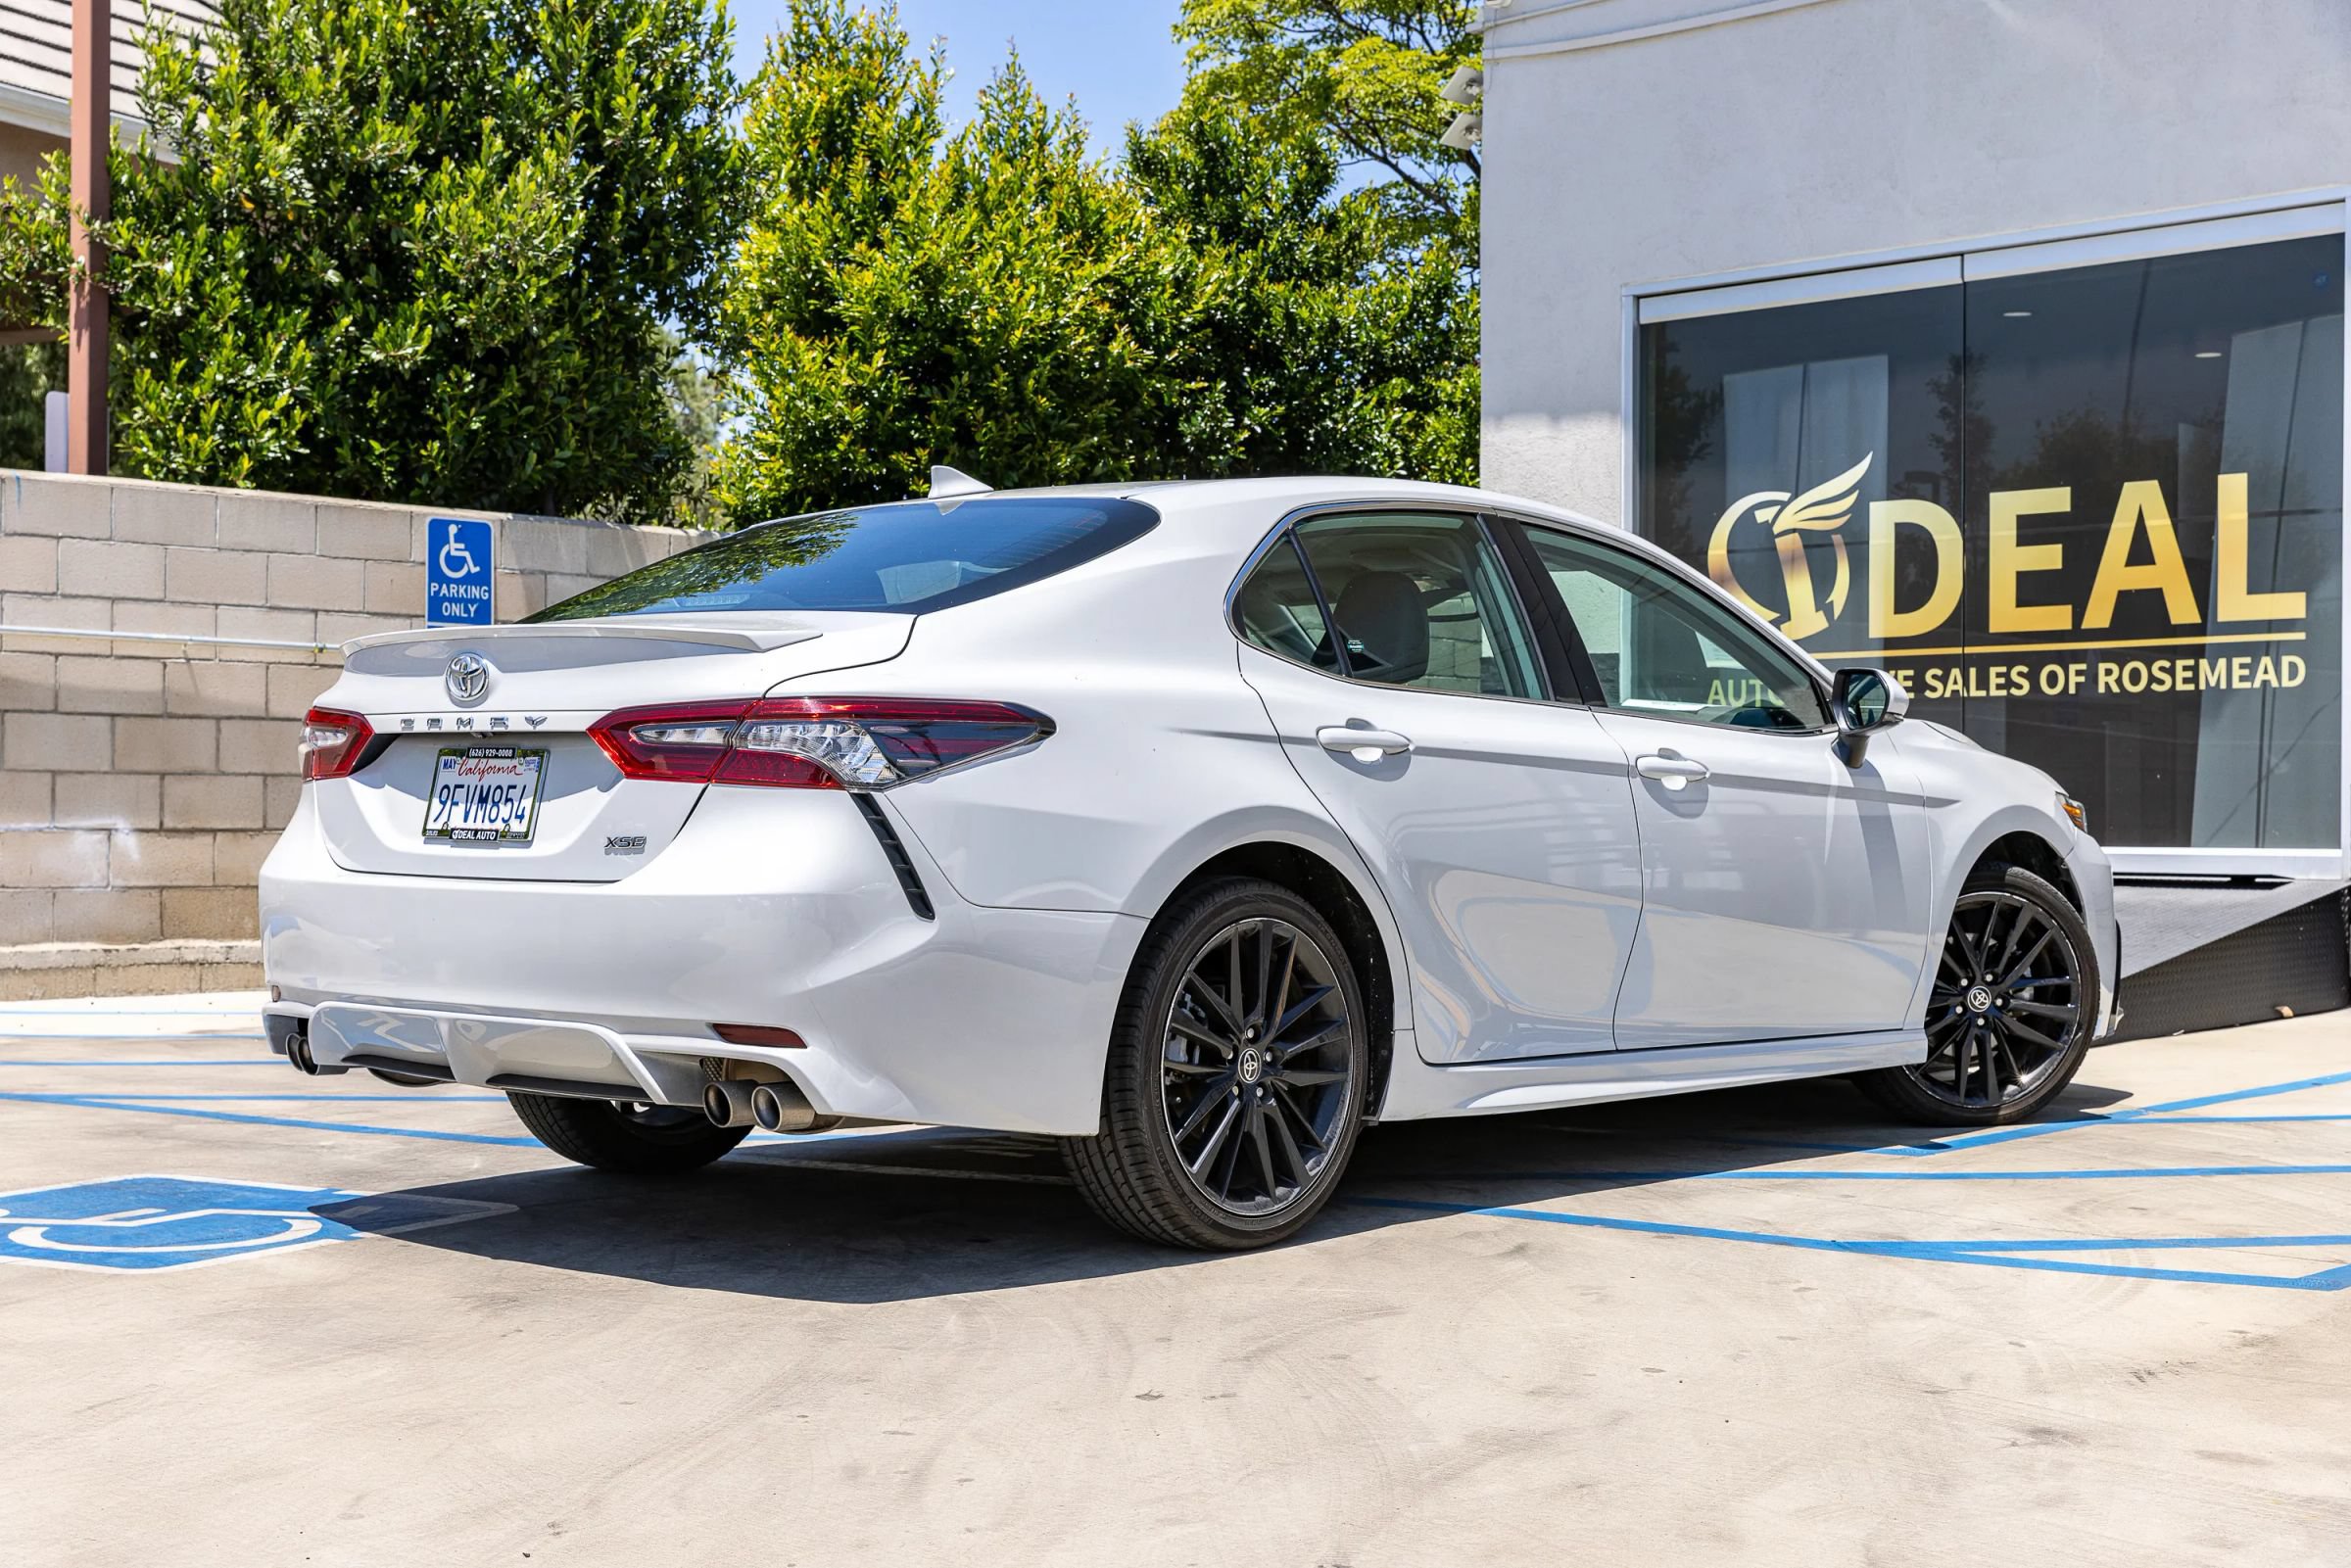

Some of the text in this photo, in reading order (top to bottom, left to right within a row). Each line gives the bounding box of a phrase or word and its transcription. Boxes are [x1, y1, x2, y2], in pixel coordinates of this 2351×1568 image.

[430, 582, 490, 600] PARKING
[442, 601, 479, 618] ONLY
[1923, 666, 2031, 699] SALES
[2039, 663, 2086, 696] OF
[2097, 655, 2307, 693] ROSEMEAD
[400, 715, 549, 732] CAMRY
[443, 758, 456, 771] MAY
[457, 758, 523, 783] California
[433, 784, 527, 825] 9FVM854
[475, 831, 496, 840] AUTO
[604, 836, 647, 849] XSE
